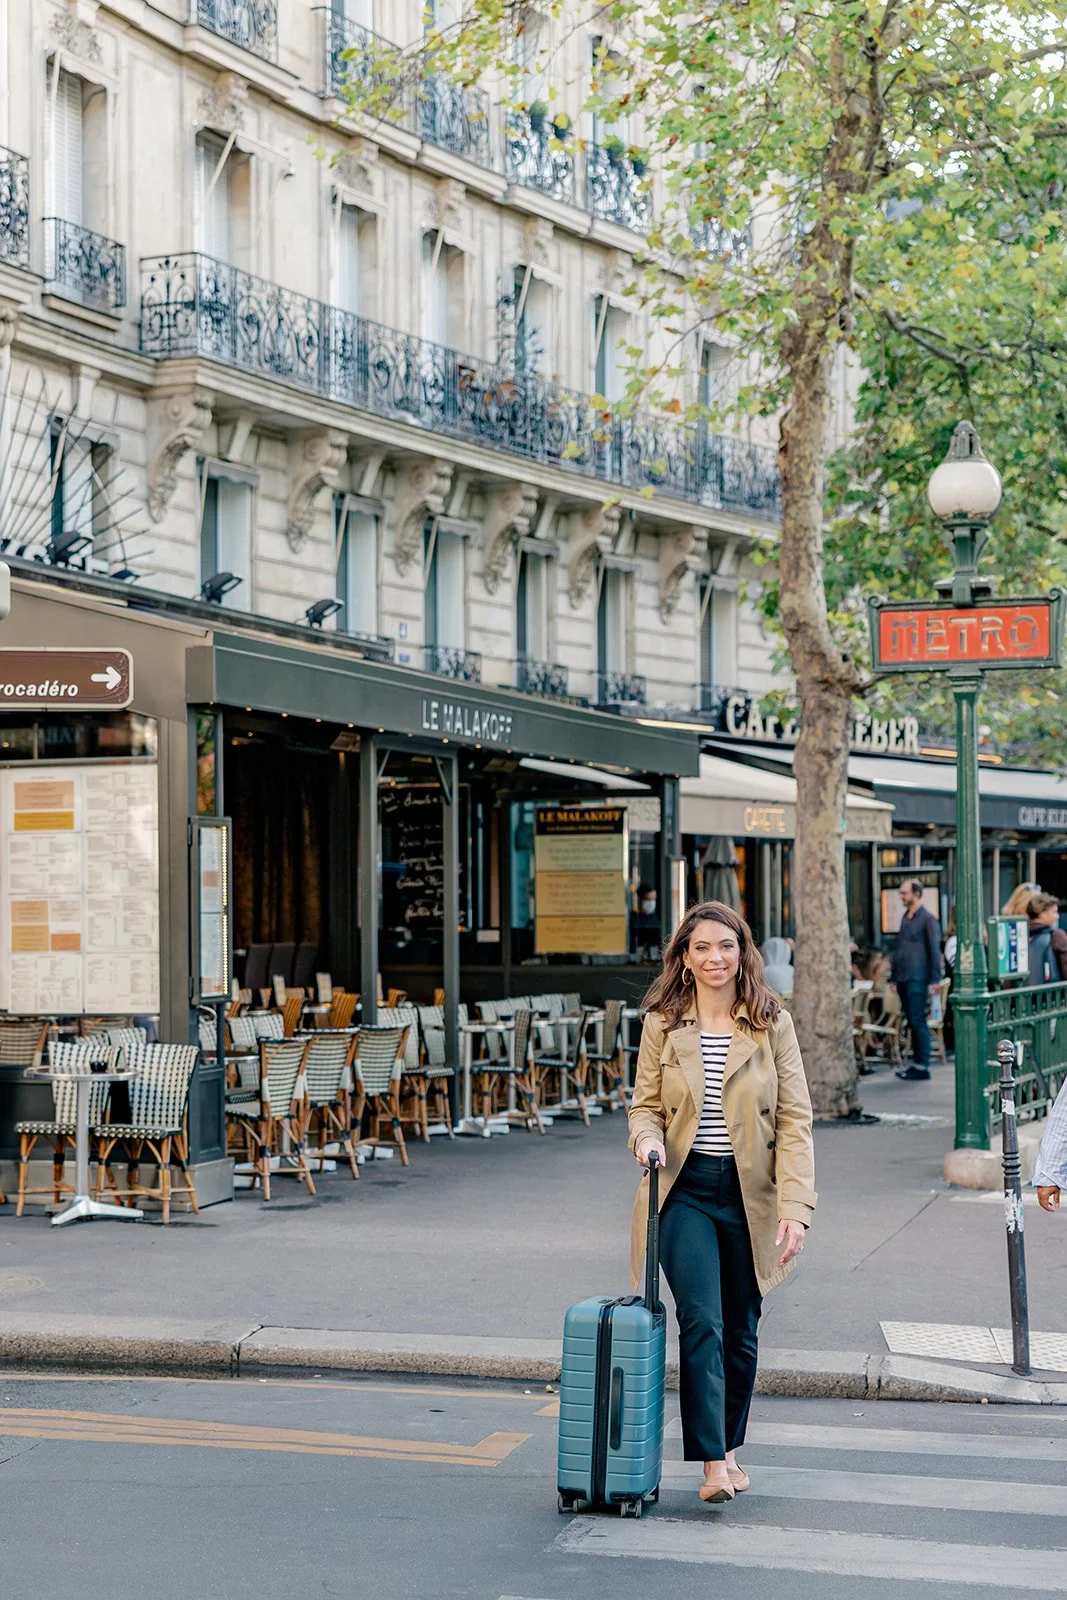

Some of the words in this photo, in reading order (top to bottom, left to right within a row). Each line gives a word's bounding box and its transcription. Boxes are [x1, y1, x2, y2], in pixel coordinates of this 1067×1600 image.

[891, 614, 1038, 655] METRO
[422, 700, 439, 731] LE
[443, 703, 513, 743] MALAKOFF
[539, 811, 554, 822] LE
[557, 809, 621, 822] MALAKOFF
